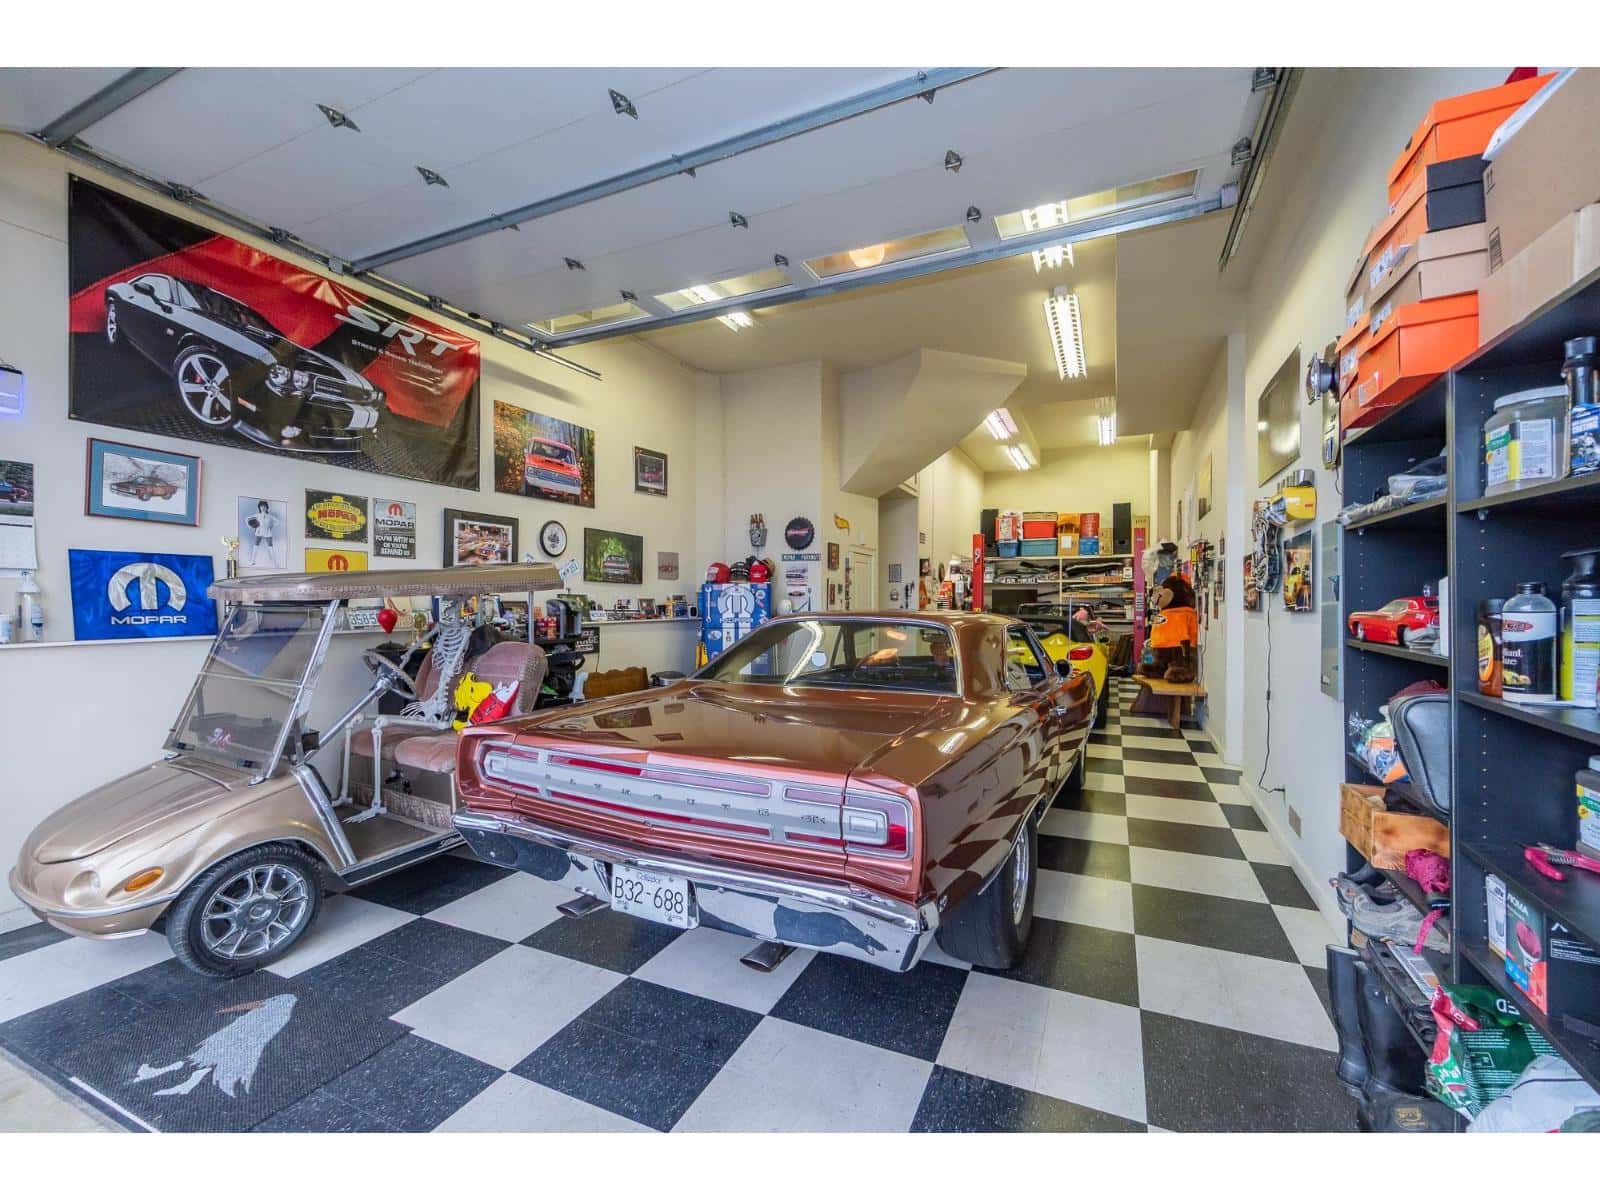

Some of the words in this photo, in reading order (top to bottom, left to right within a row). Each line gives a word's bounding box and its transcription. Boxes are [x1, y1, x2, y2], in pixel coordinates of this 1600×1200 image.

[334, 304, 460, 356] SRT
[375, 518, 415, 528] MOPAR
[111, 614, 188, 625] MOPAR
[614, 876, 684, 914] B32-688
